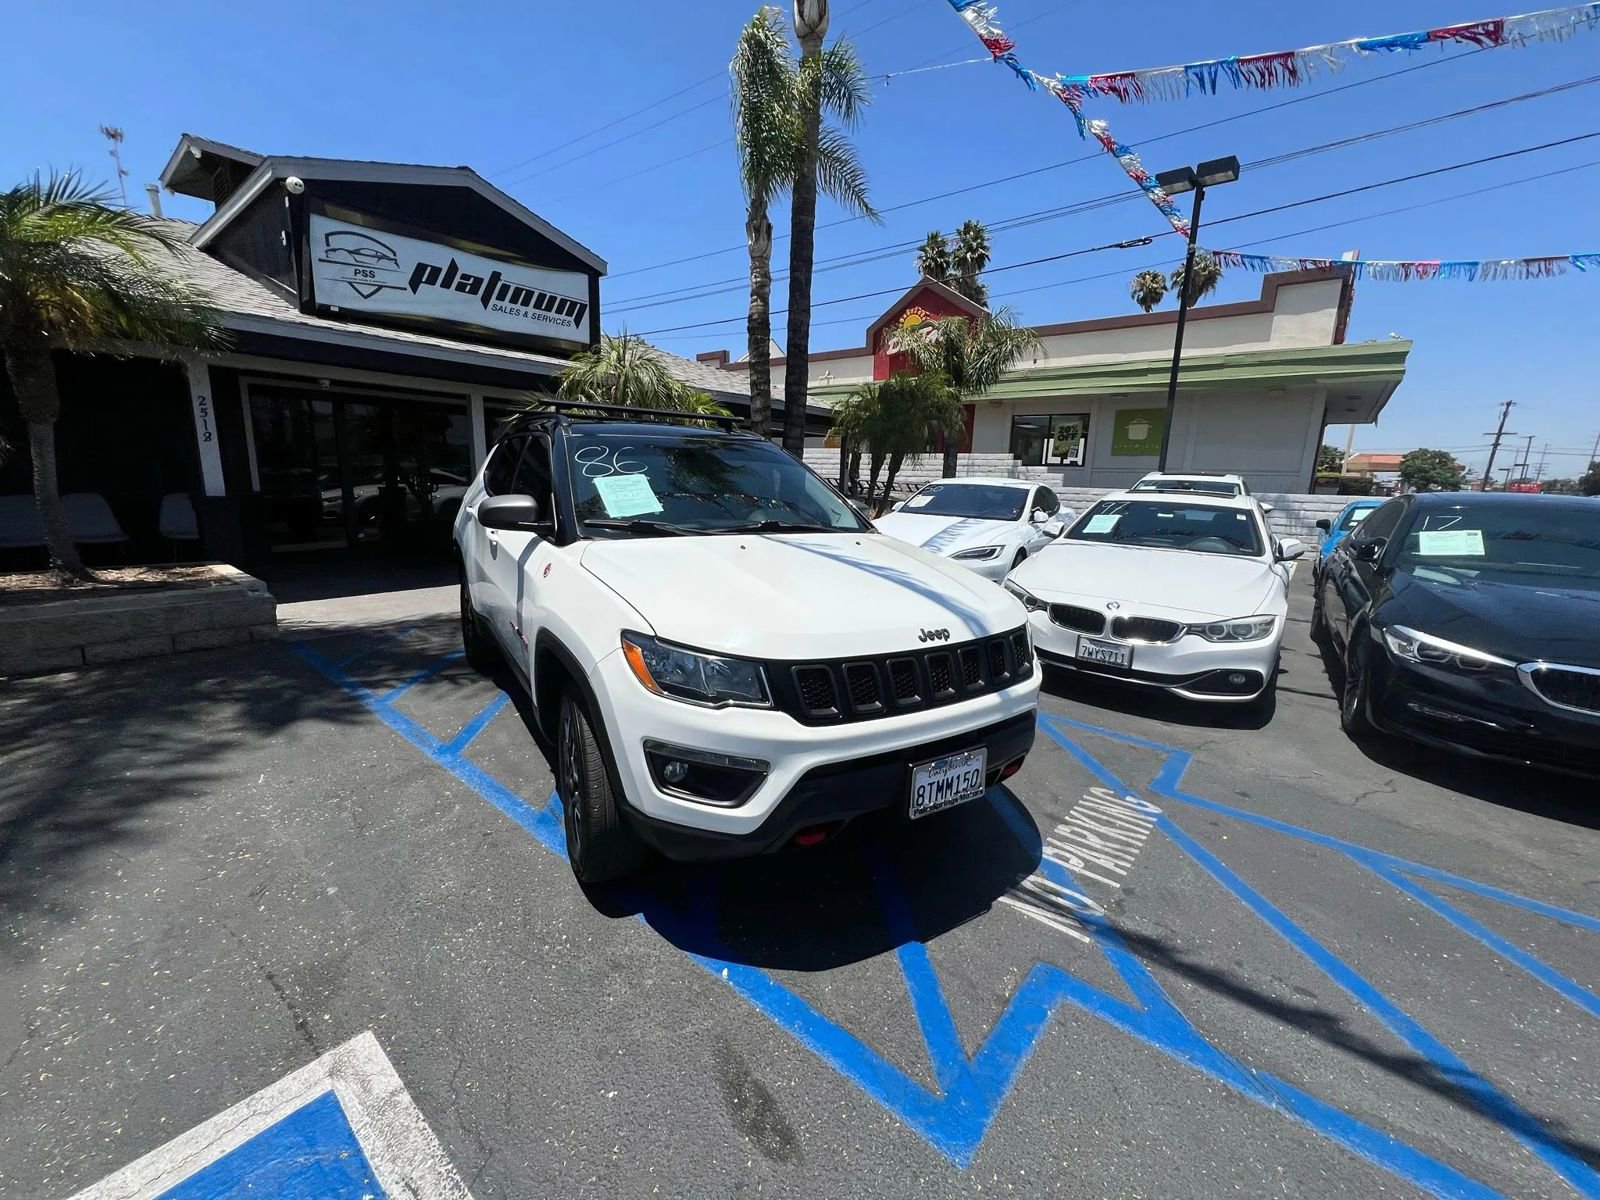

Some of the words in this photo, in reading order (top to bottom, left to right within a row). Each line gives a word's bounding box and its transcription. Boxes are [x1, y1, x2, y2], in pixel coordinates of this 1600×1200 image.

[353, 268, 376, 279] PSS
[491, 303, 521, 317] SALES
[522, 310, 529, 318] &
[531, 312, 572, 328] SERVICES
[1057, 432, 1079, 442] OFF
[1058, 424, 1079, 434] 20%
[575, 445, 648, 477] 86
[918, 628, 950, 643] Jeep
[1081, 645, 1125, 663] 7WYS711
[915, 768, 981, 807] 8TMM150
[1041, 786, 1163, 888] PARKING
